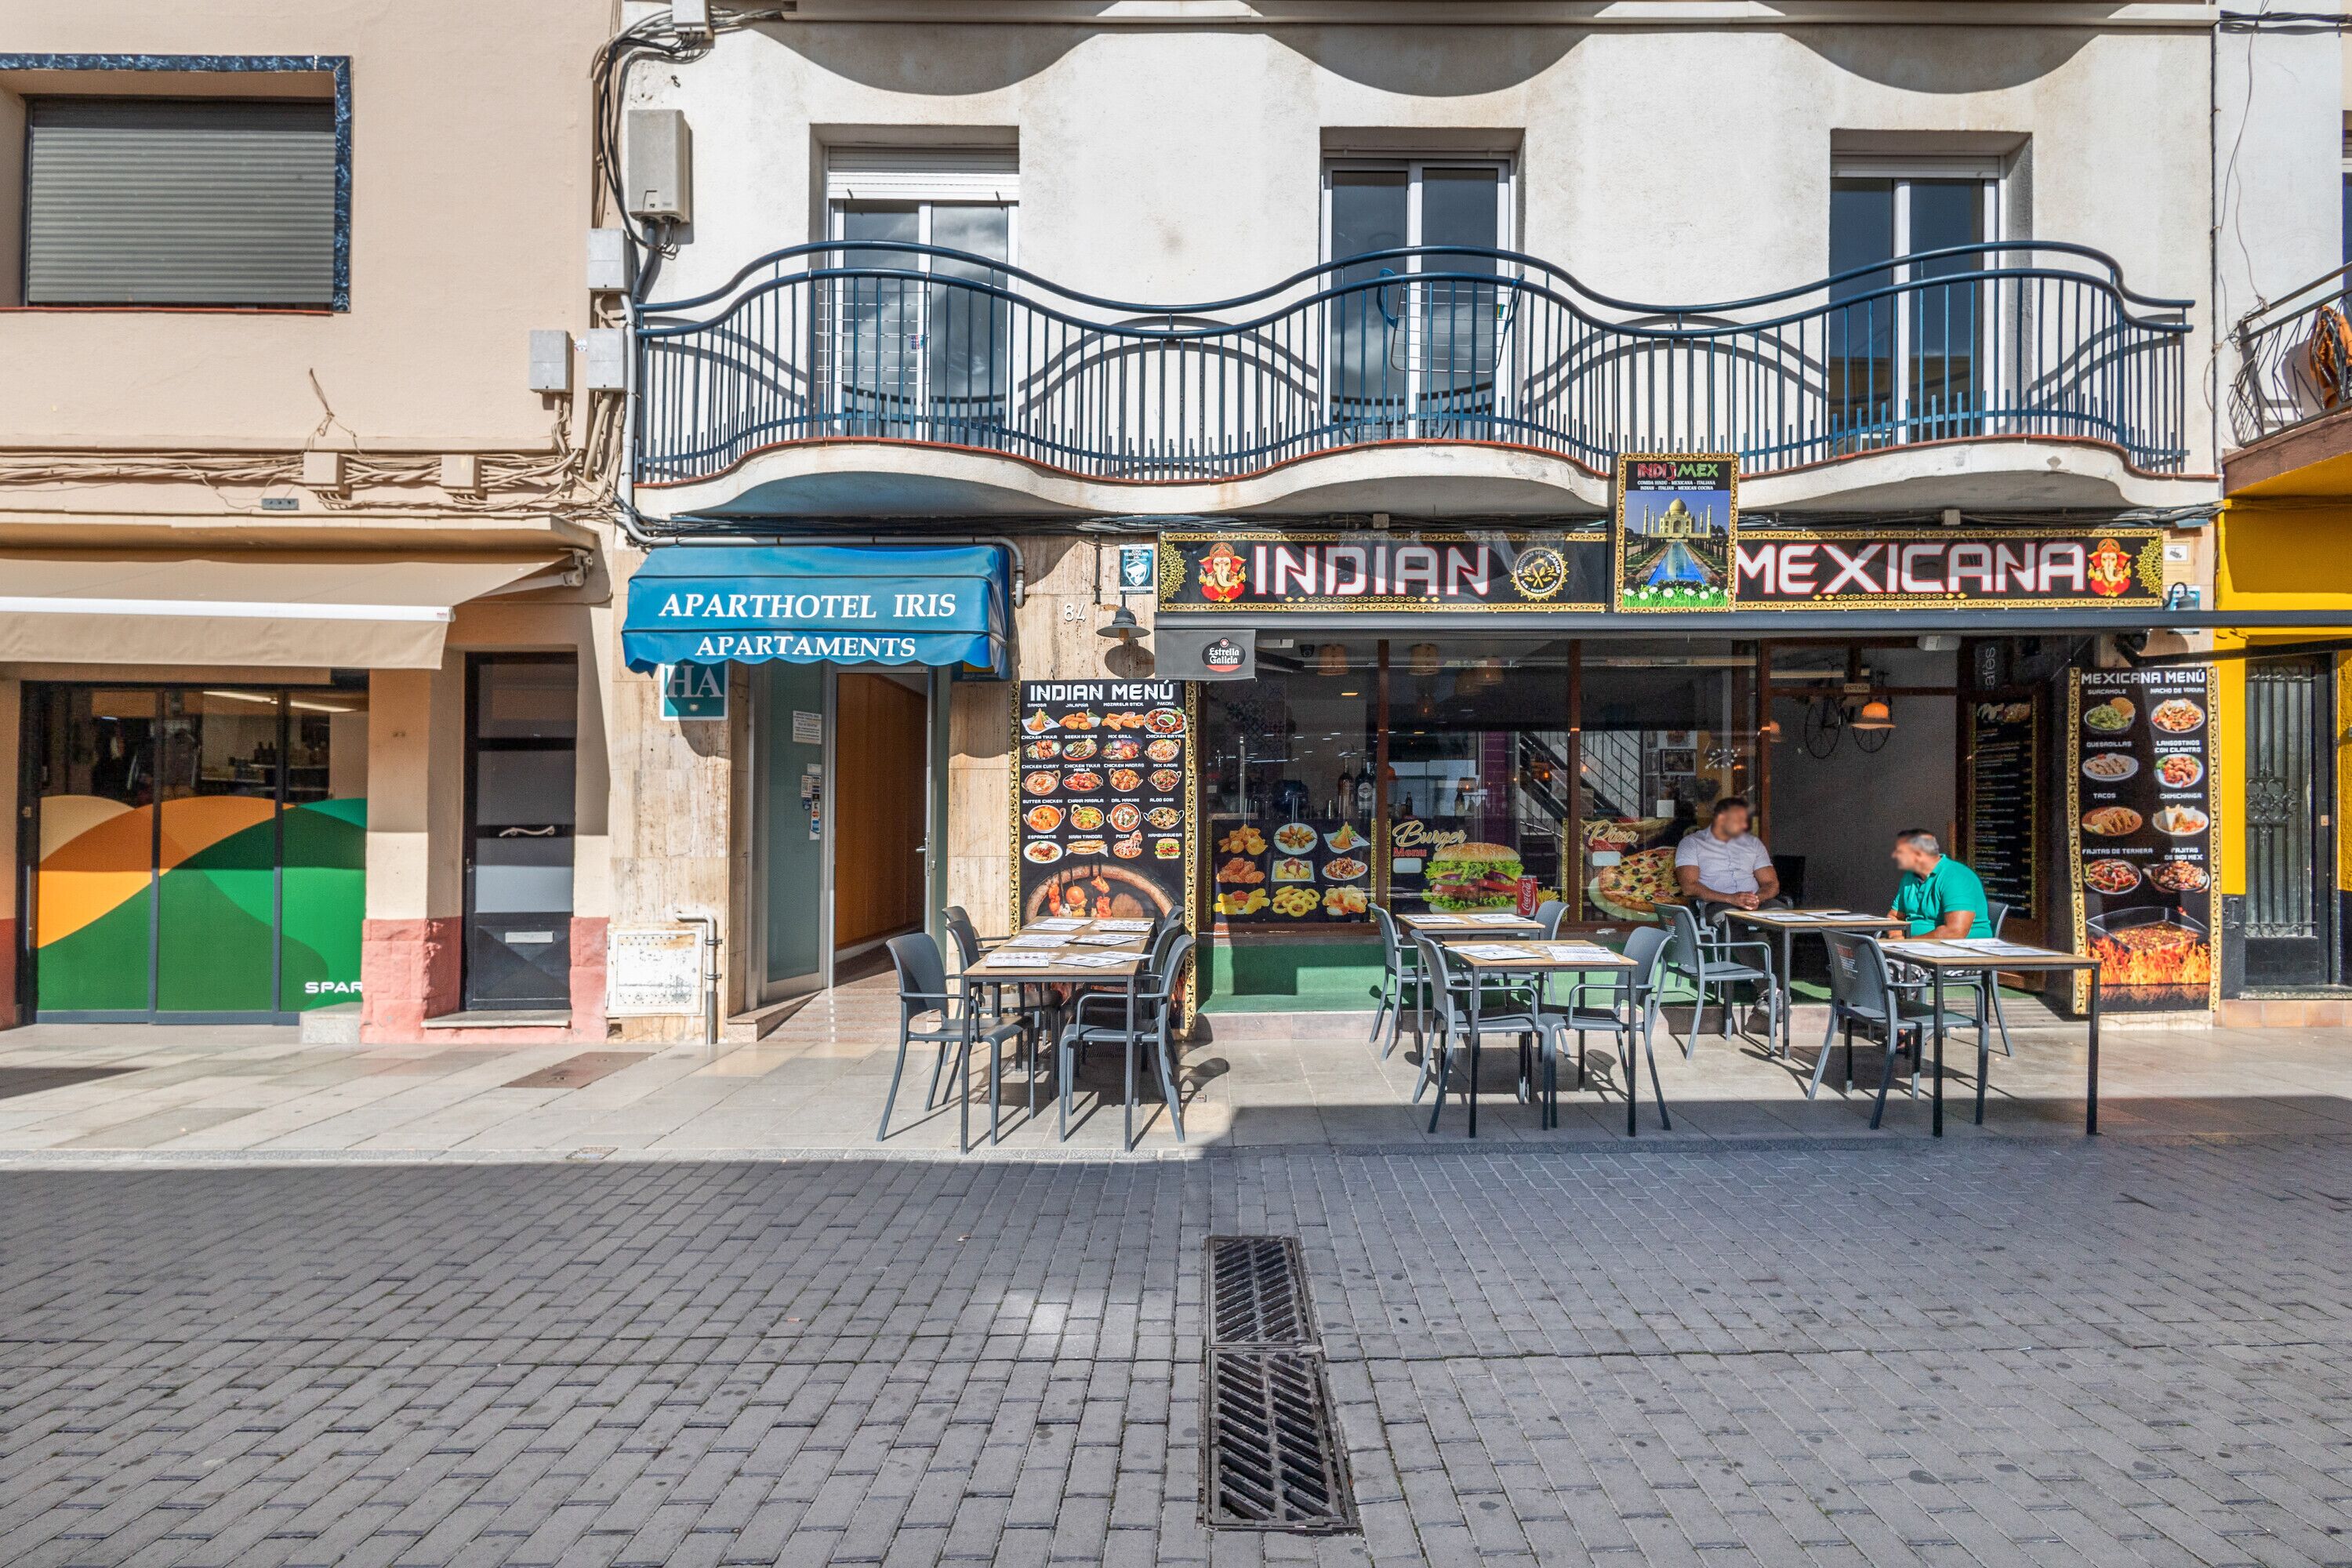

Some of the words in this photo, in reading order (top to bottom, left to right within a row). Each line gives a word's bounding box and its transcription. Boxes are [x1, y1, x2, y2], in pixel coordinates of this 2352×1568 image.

[1677, 463, 1719, 477] MEX
[1519, 552, 1534, 569] INDIAN
[1535, 550, 1561, 570] MEXICANA
[1736, 543, 2086, 594] MEXICANA
[1254, 545, 1489, 597] INDIAN
[1520, 579, 1529, 589] BAR
[658, 593, 877, 619] APARTHOTEL
[894, 593, 956, 618] IRIS
[1065, 602, 1087, 622] 84
[695, 636, 916, 657] APARTAMENTS
[1208, 647, 1240, 656] Estrella
[1210, 655, 1238, 664] Galicia
[665, 664, 724, 698] HA
[2081, 671, 2161, 684] MEXICANA
[2165, 668, 2205, 684] MENÚ
[1029, 684, 1103, 701] INDIAN
[1111, 679, 1174, 701] MENÚ
[1392, 819, 1467, 851] Burger
[1584, 818, 1639, 847] Pizza
[1392, 847, 1427, 858] Menu
[304, 981, 363, 994] SPAR
